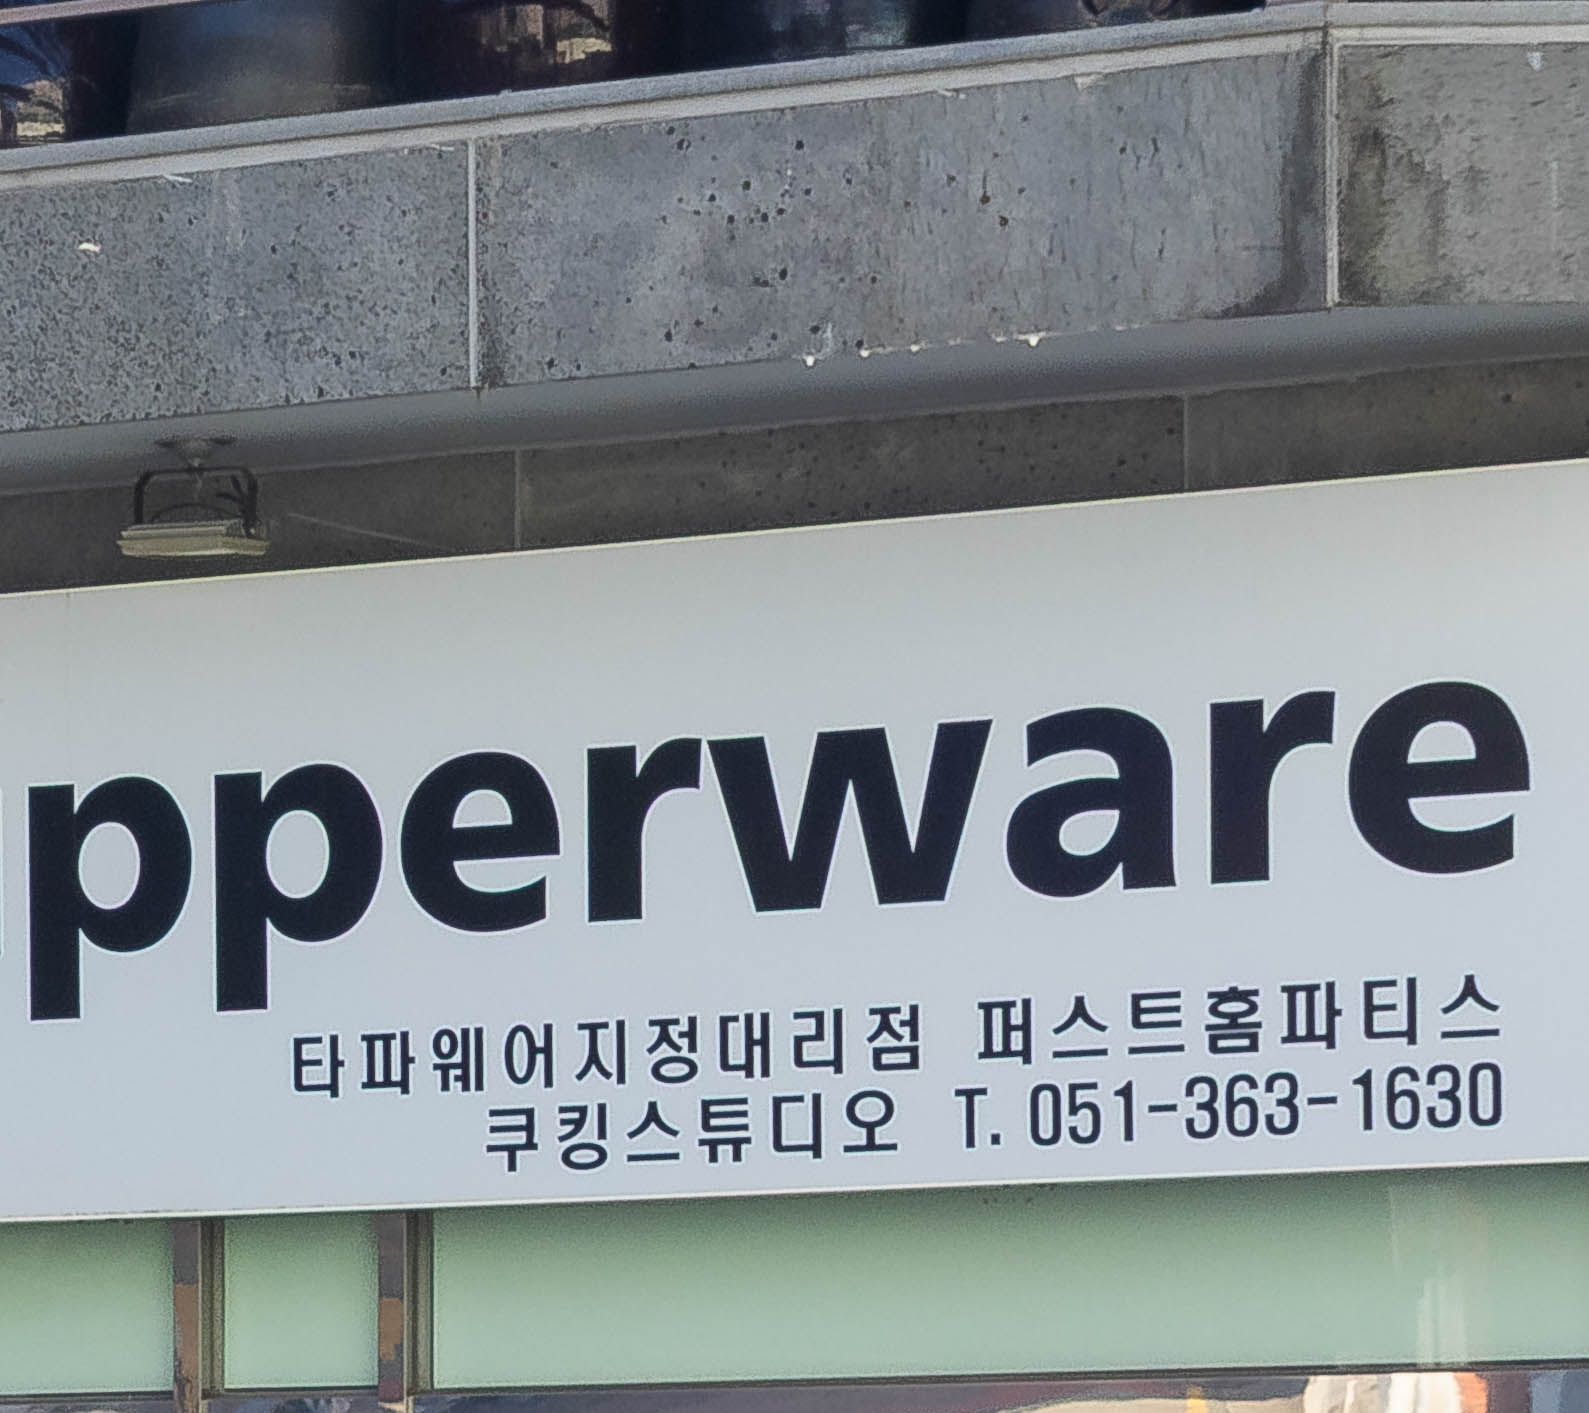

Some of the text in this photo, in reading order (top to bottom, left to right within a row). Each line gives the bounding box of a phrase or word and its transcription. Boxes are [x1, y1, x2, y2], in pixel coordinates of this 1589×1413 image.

[292, 974, 1500, 1099] 타파웨어지정대리점 퍼스트홈파티스
[486, 1061, 1503, 1173] 쿠킹스튜디오 T. 051-363-1630
